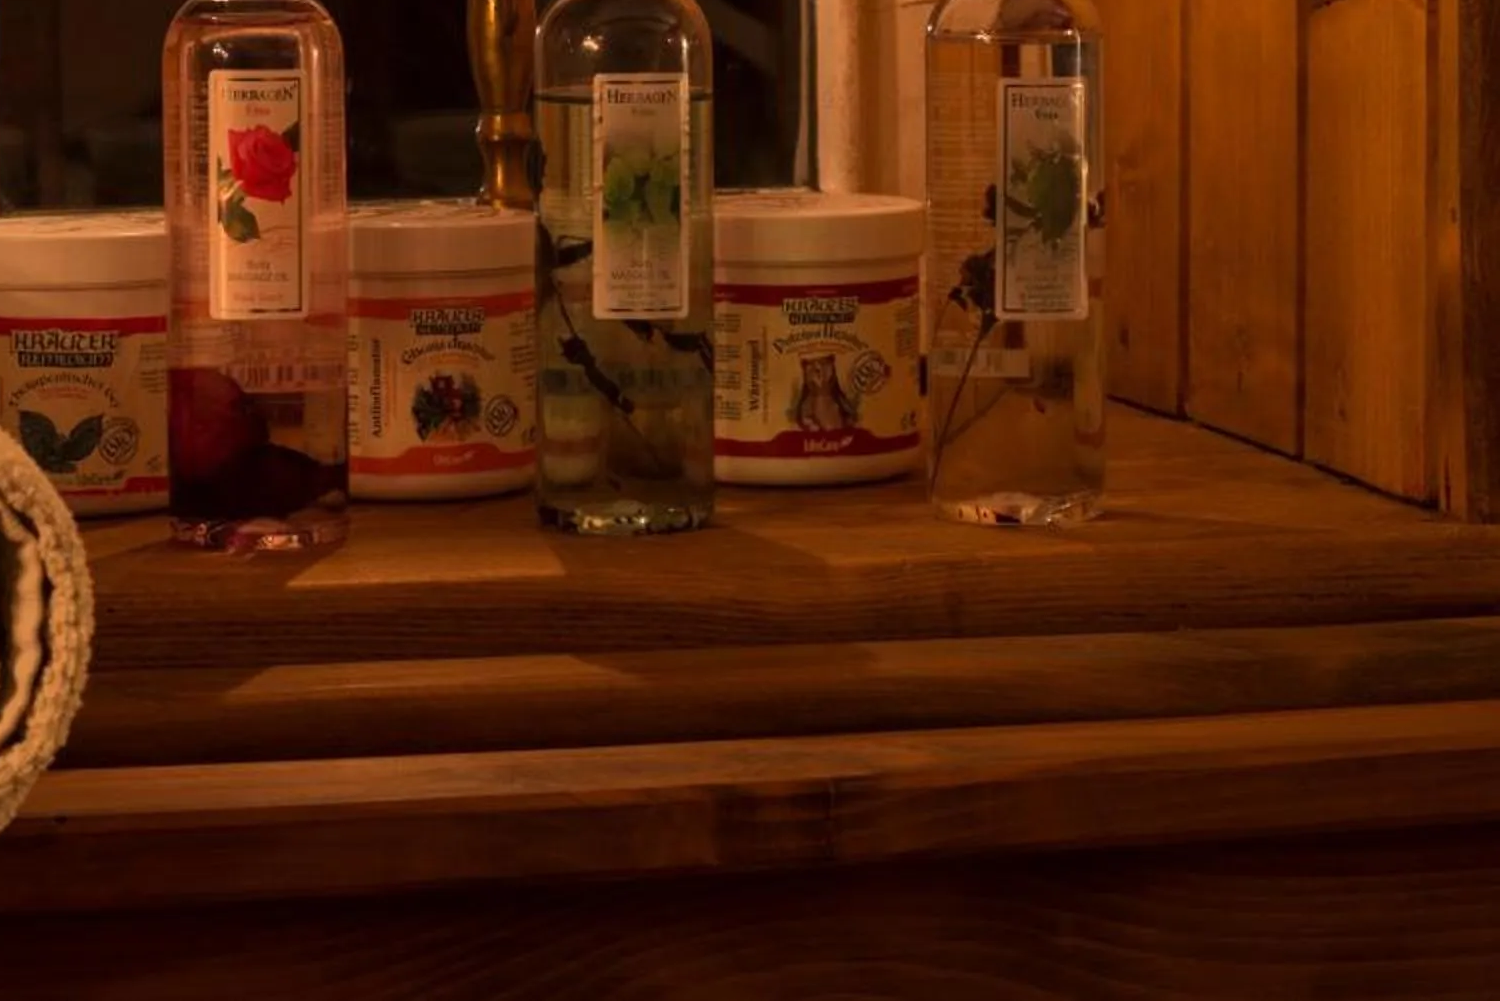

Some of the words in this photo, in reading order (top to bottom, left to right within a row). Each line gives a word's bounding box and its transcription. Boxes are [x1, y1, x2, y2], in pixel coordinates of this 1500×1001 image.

[221, 86, 293, 102] HERBAGEN
[607, 88, 678, 105] HERBAGEN
[12, 329, 117, 351] KRÄUTER
